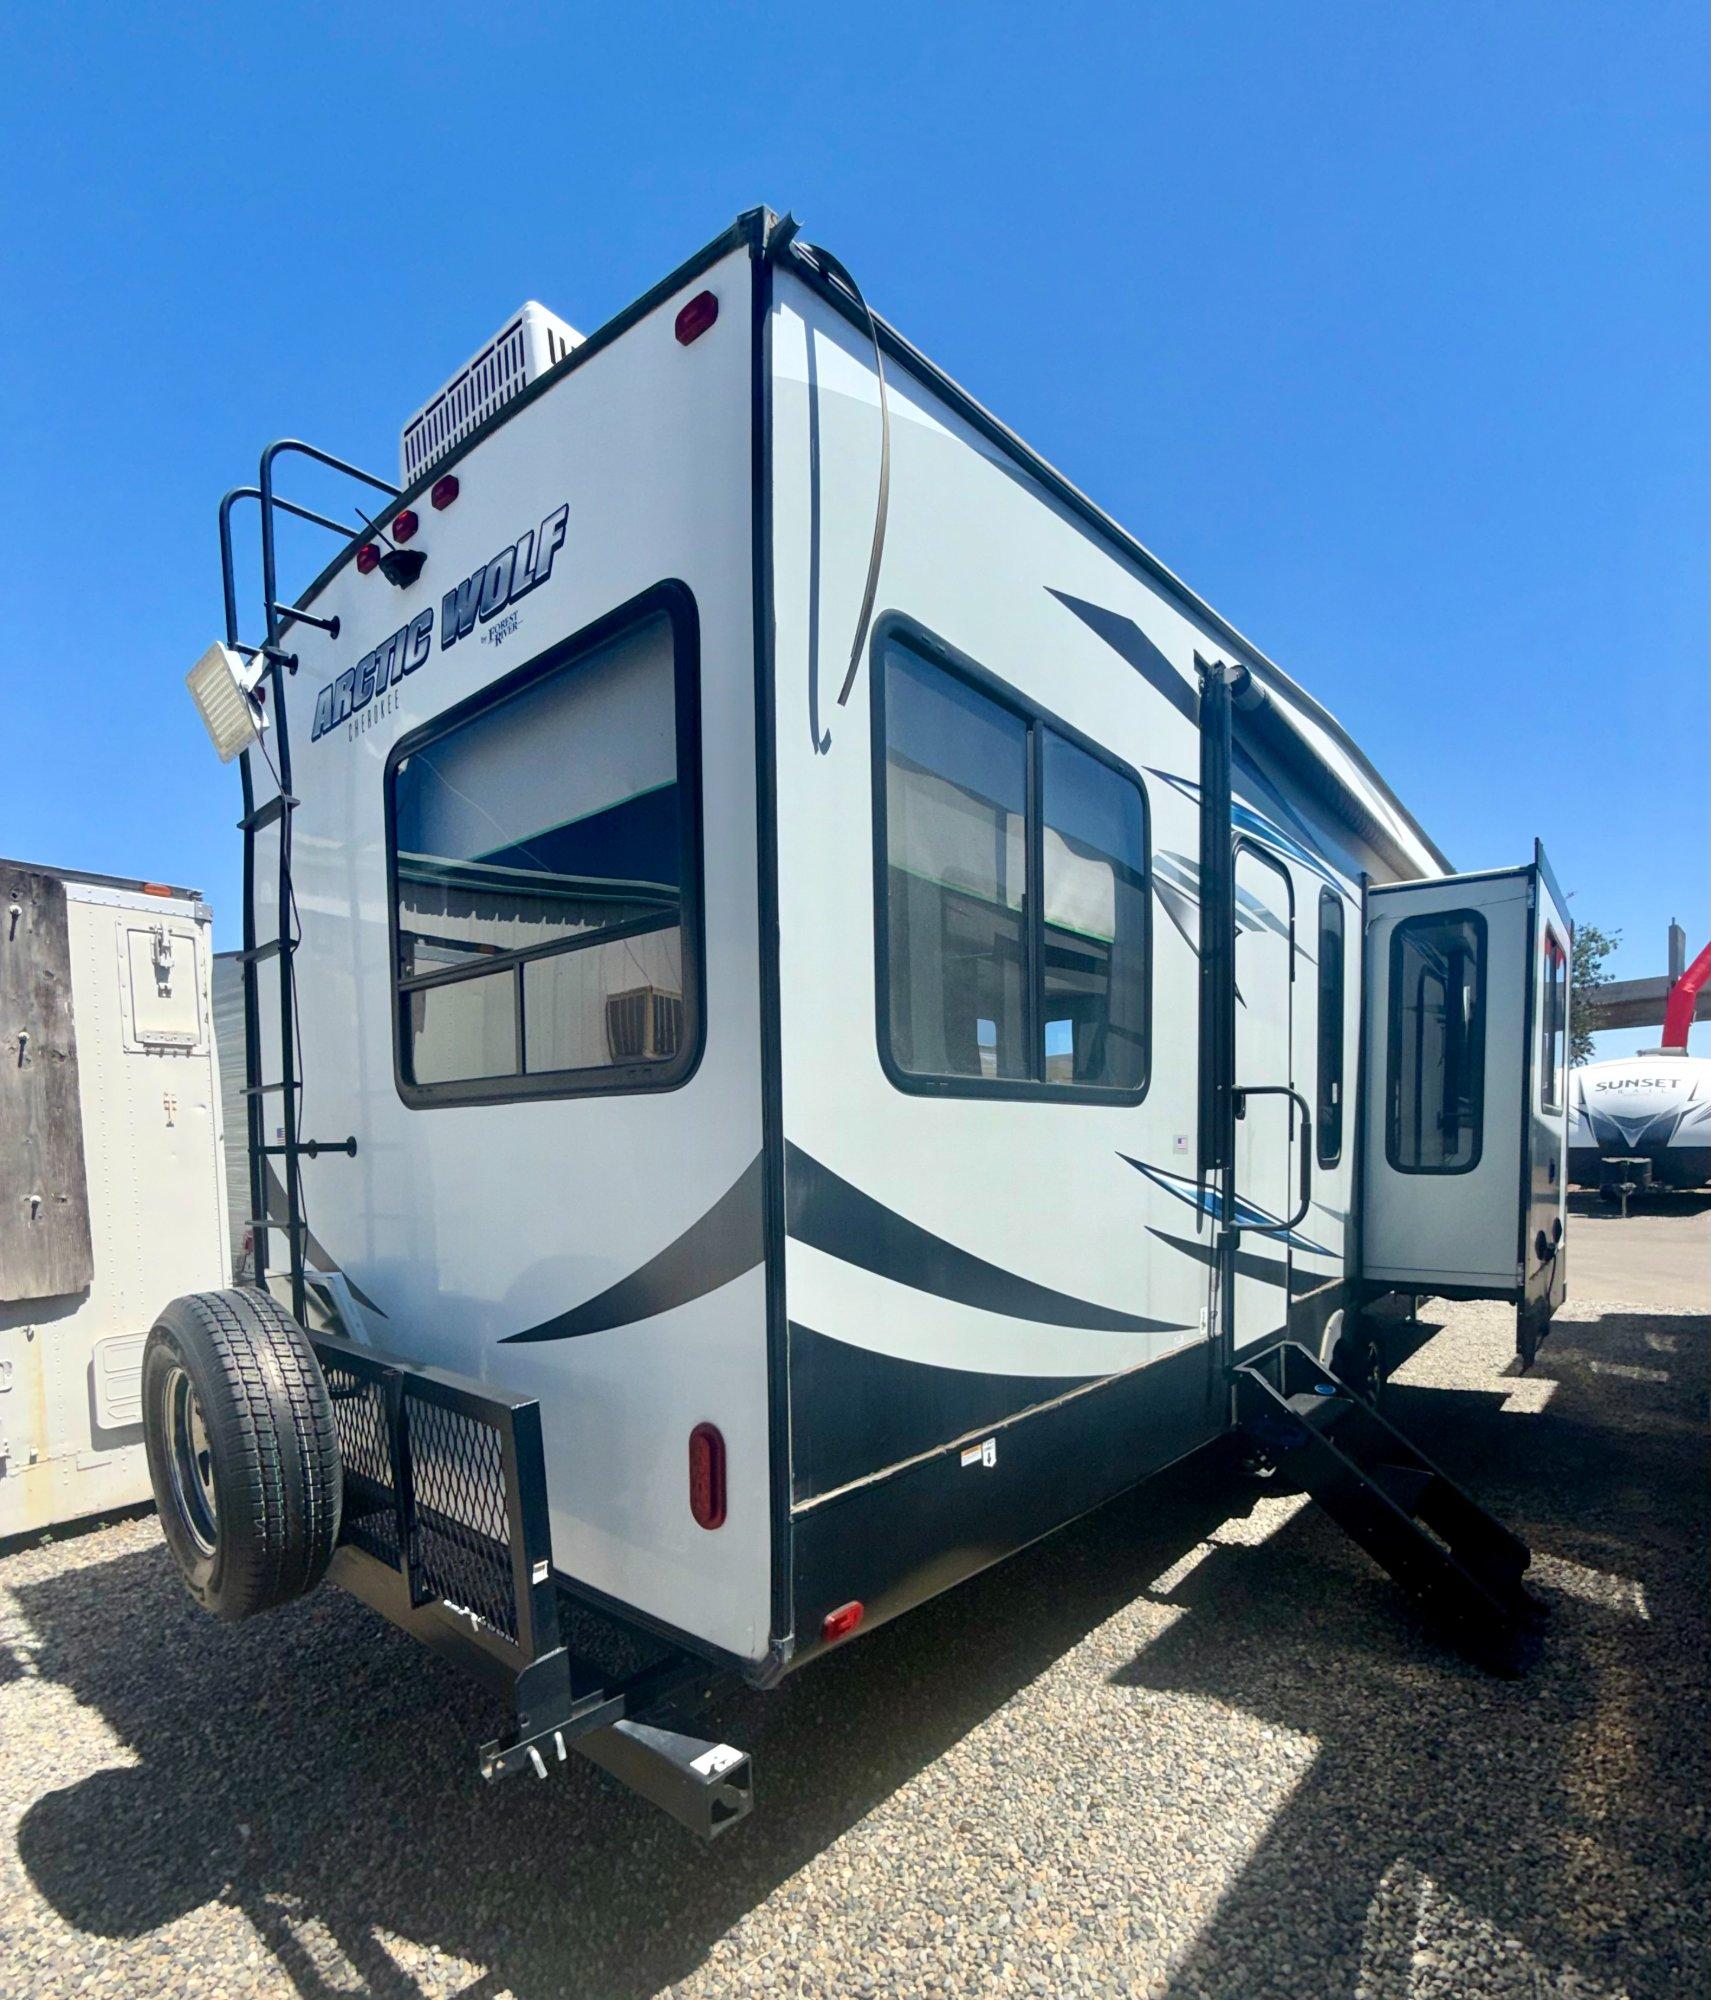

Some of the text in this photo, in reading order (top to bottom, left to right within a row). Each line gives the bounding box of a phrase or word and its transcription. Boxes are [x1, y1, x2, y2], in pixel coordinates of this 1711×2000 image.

[311, 502, 570, 743] ARCTIC WOLF
[488, 610, 519, 644] FOREST
[495, 621, 519, 648] RIVER
[348, 689, 398, 742] CHEROKEE
[1595, 1079, 1681, 1091] SUNSET
